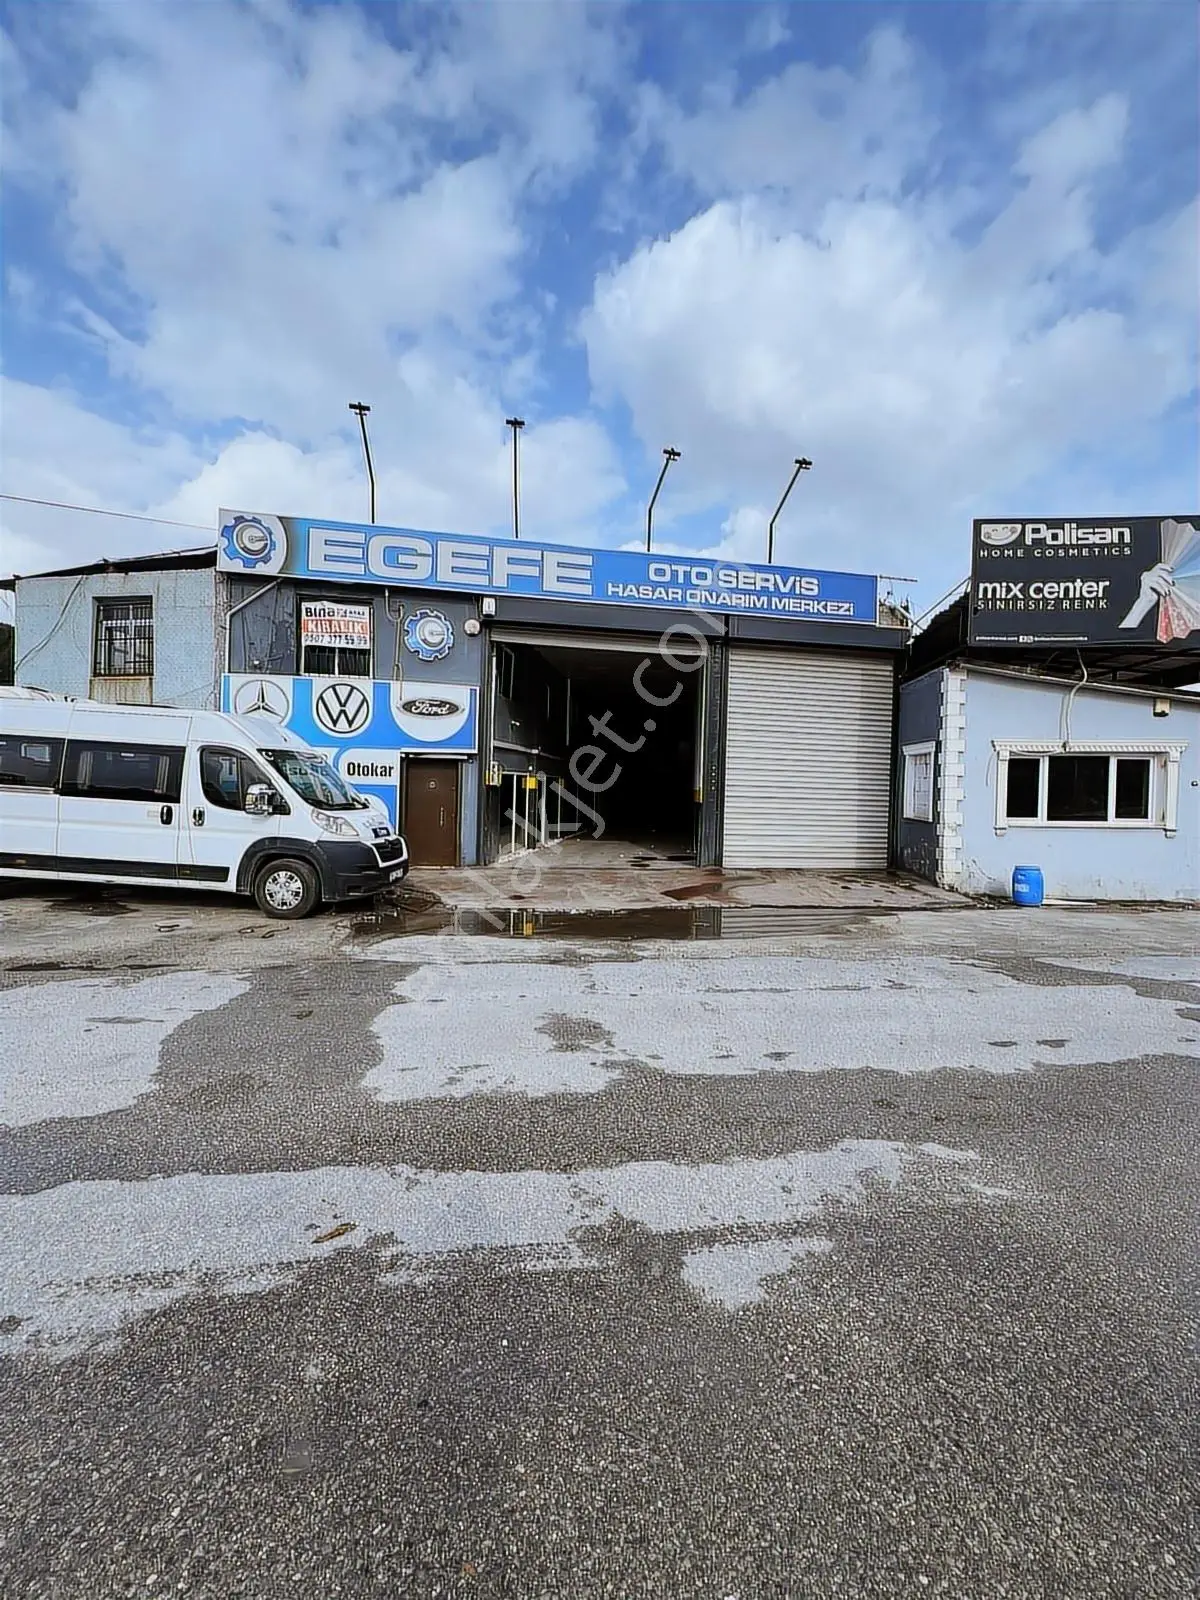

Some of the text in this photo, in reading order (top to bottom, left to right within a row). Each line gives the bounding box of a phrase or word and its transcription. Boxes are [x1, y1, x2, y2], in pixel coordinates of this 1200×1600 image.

[1024, 522, 1132, 546] Polisan
[307, 526, 594, 597] EGEFE
[979, 546, 1132, 559] HOME COSMETICS
[648, 561, 713, 587] OTO
[607, 582, 683, 602] HASAR
[686, 588, 768, 610] ONARIM
[978, 578, 1110, 600] mix center
[977, 599, 1108, 610] SINIRSIZ RENK
[308, 619, 364, 634] KIRALIK
[410, 699, 451, 715] Ford
[346, 761, 395, 777] Otokar
